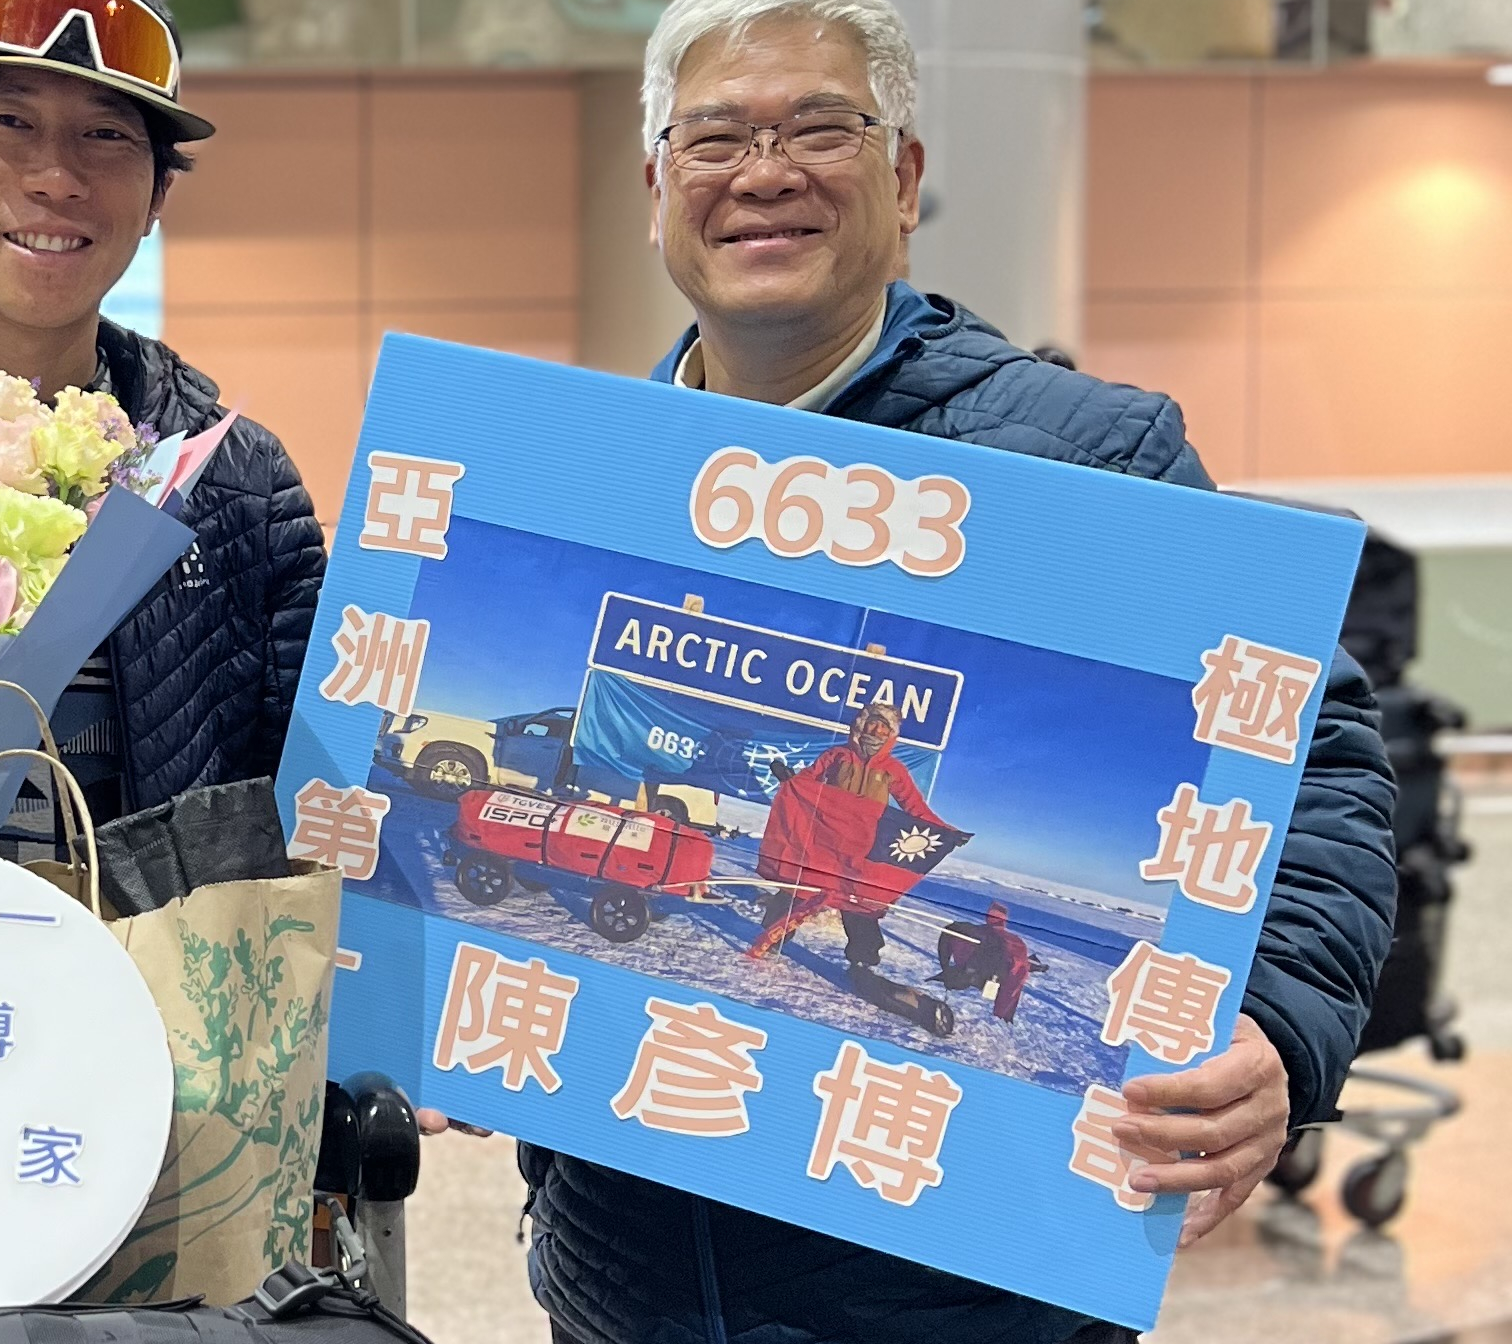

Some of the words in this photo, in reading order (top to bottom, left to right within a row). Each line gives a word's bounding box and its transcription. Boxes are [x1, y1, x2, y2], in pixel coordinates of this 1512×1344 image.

[694, 450, 969, 575] 6633
[614, 617, 768, 685] ARCTIC
[786, 659, 933, 724] OCEAN
[437, 945, 961, 1203] 陳彥博
